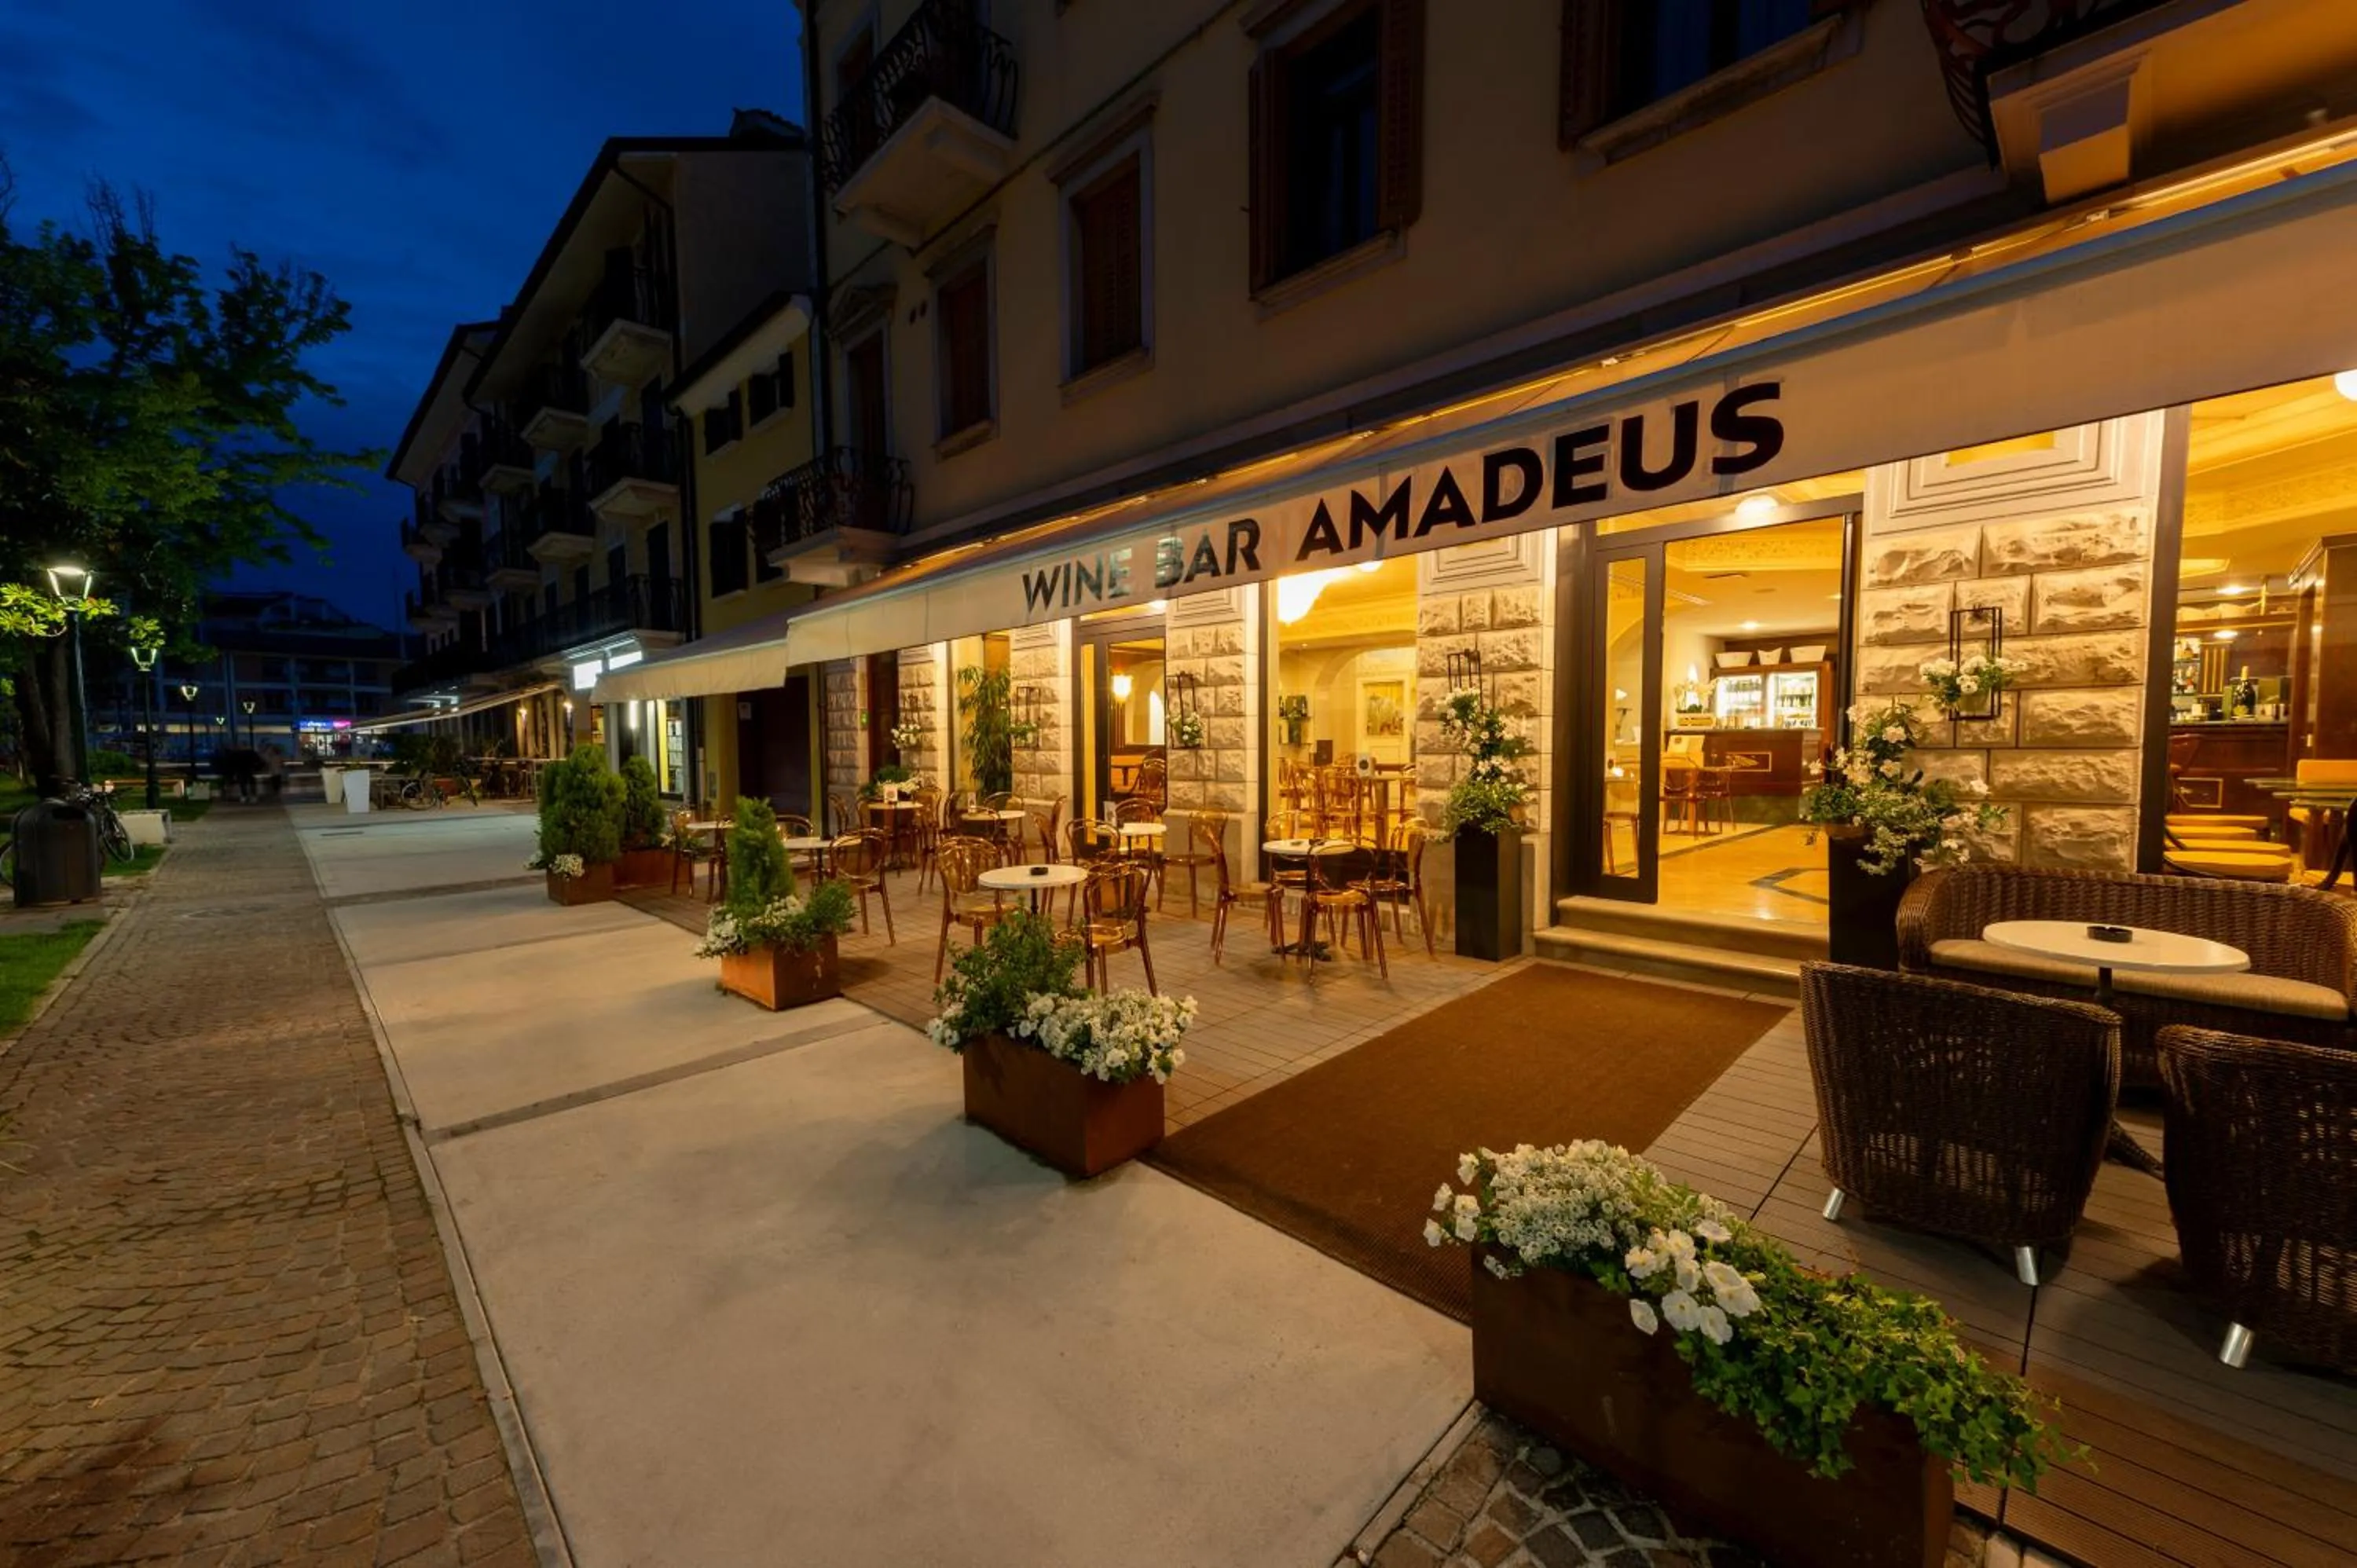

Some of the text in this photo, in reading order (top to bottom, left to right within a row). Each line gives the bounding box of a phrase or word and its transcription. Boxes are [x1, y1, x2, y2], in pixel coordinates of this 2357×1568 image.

[1022, 382, 1784, 613] WINE BAR AMADEUS
